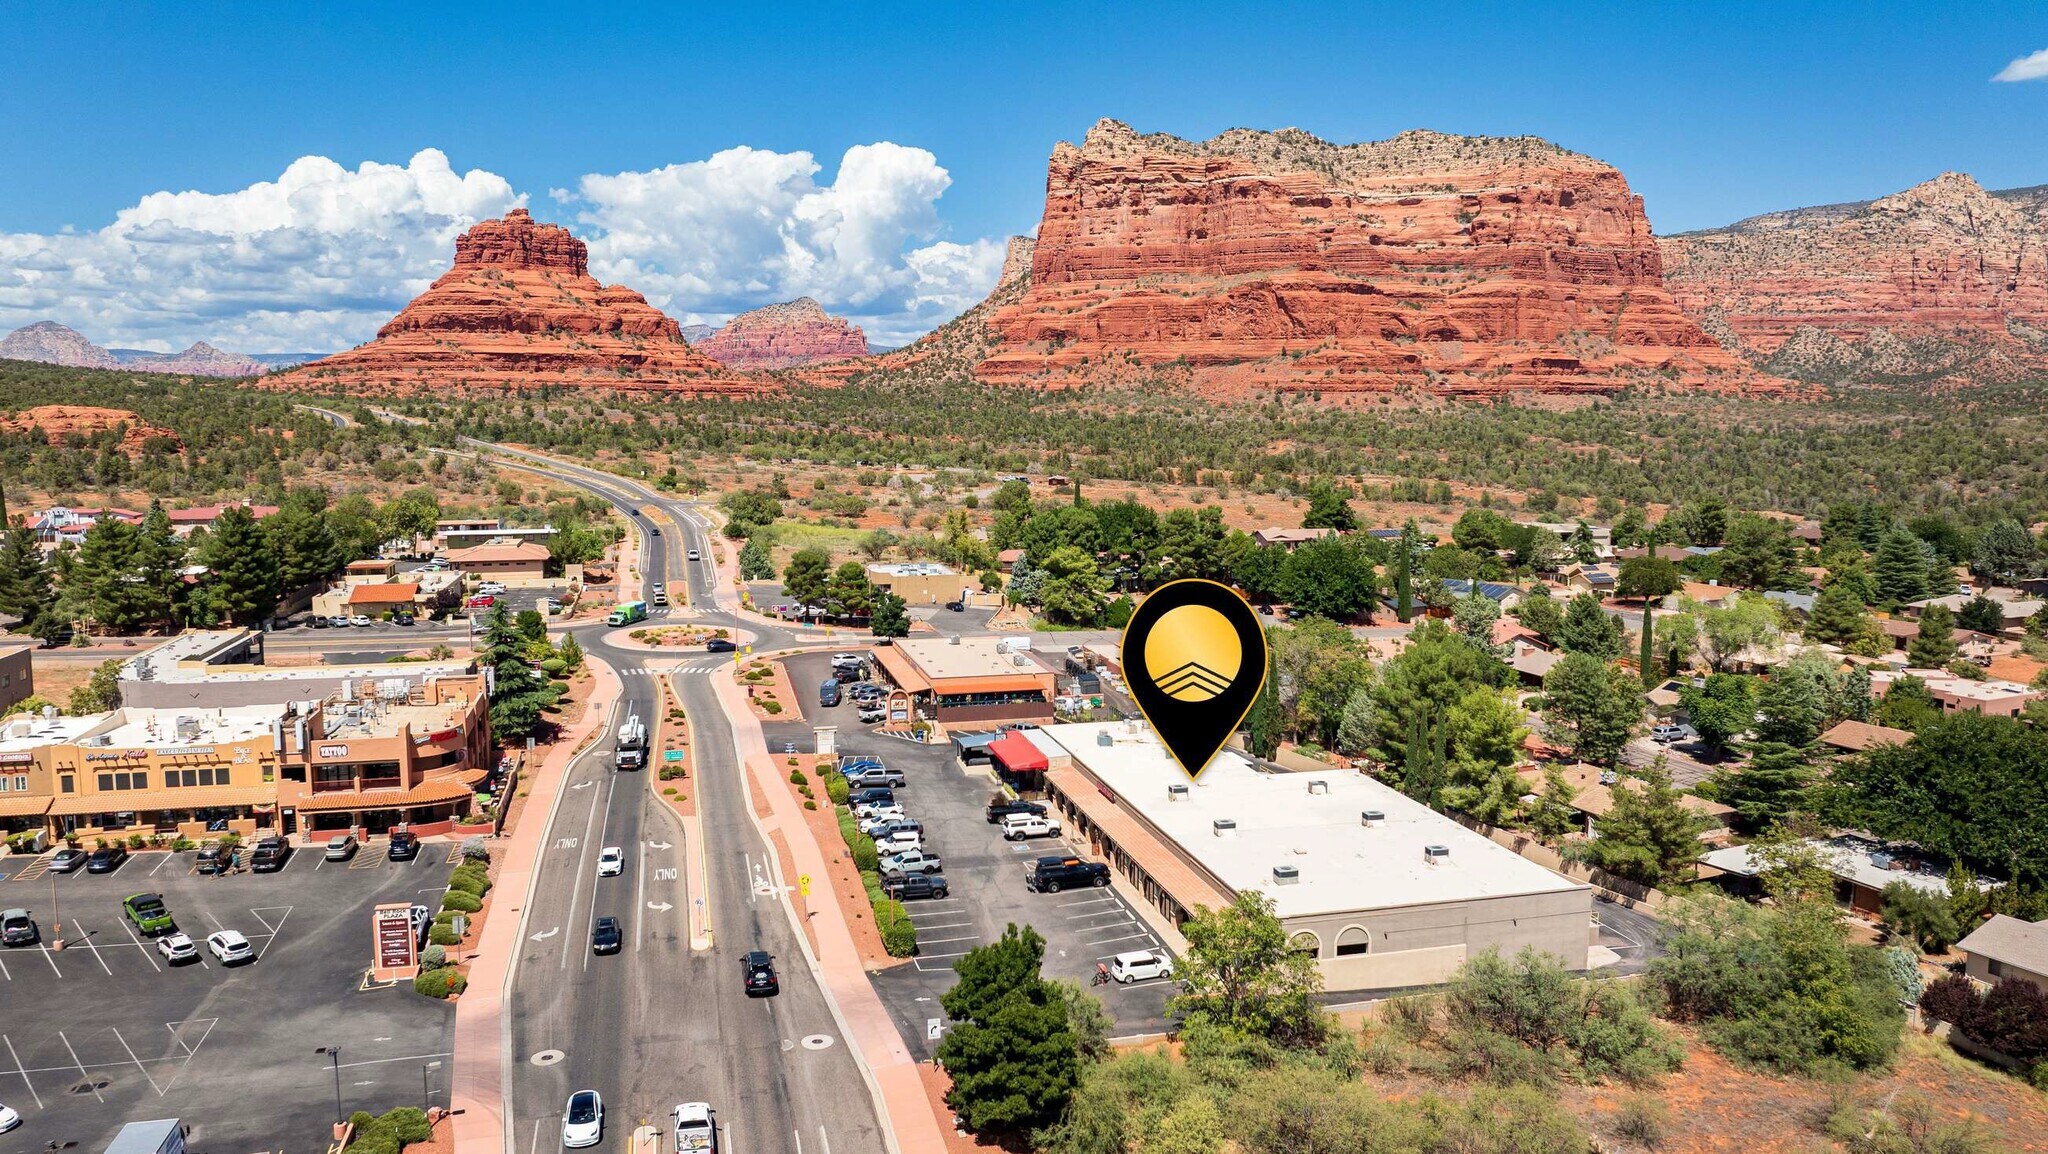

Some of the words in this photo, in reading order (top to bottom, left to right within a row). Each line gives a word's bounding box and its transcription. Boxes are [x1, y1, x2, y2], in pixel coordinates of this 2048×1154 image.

[320, 746, 347, 756] TATTOO
[554, 838, 577, 849] ONLY
[654, 868, 677, 880] ONLY
